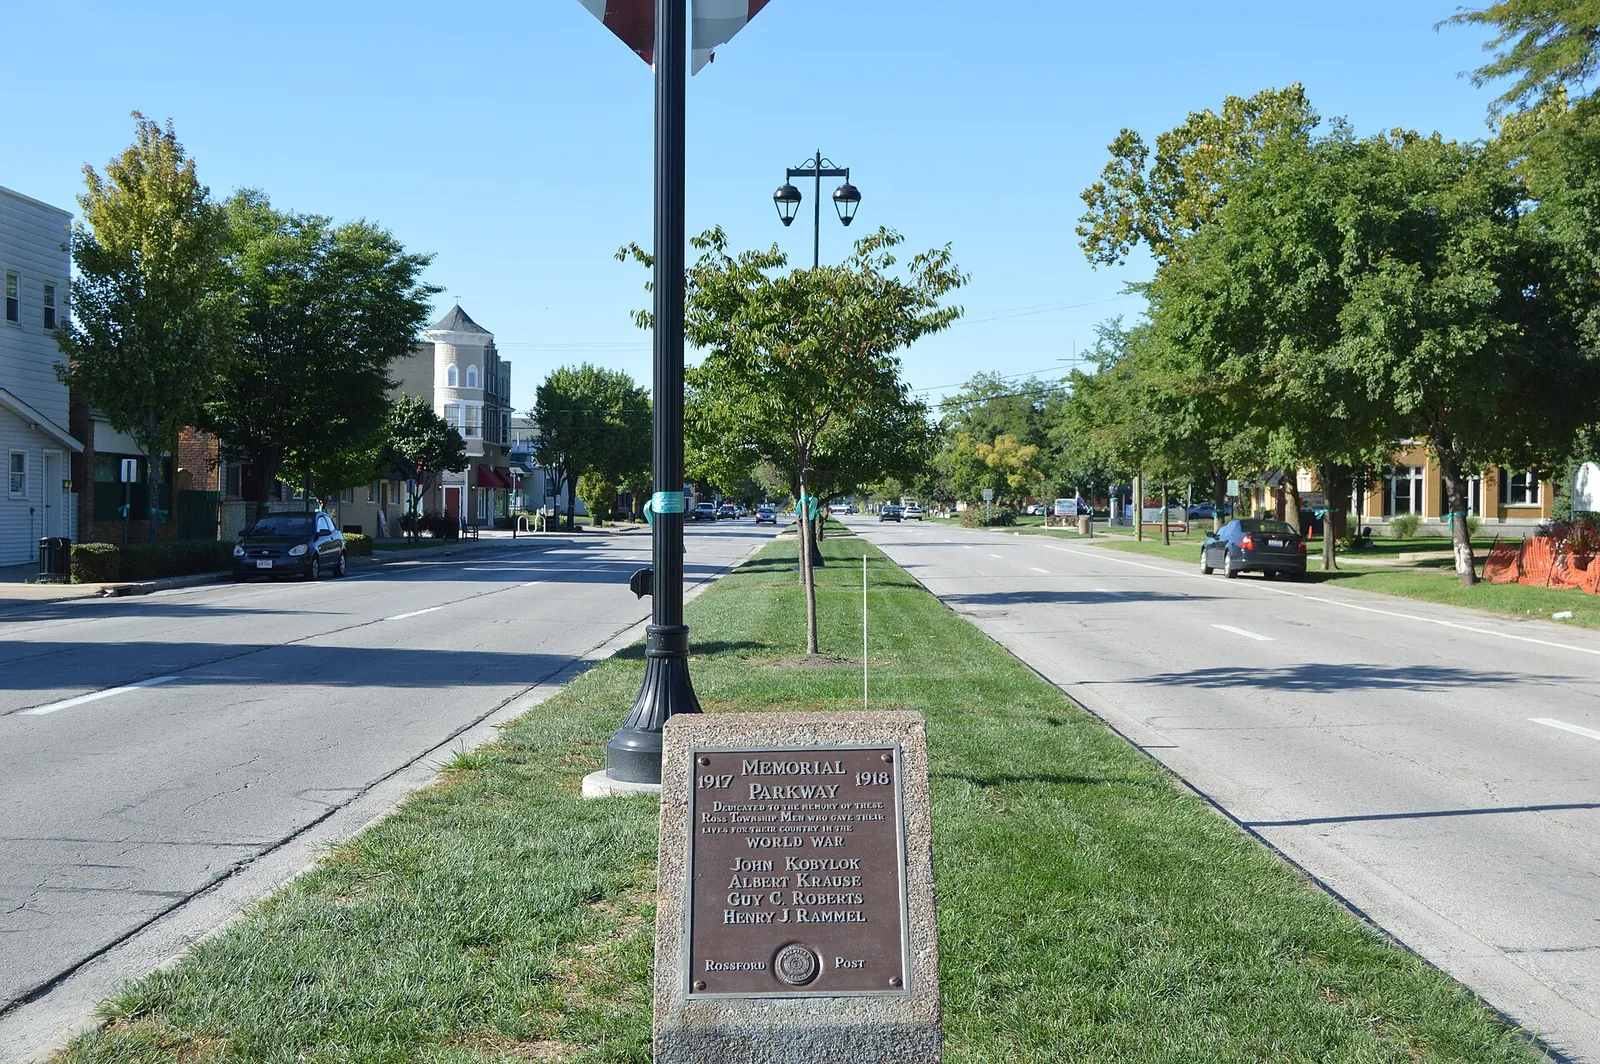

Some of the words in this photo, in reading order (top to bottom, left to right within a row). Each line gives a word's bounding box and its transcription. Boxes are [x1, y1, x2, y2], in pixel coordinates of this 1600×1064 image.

[741, 759, 846, 776] MEMORIAL
[698, 774, 734, 788] 1917
[855, 771, 890, 786] 1918
[749, 783, 839, 800] PARKWAY
[713, 801, 766, 812] DEDICATED
[701, 812, 727, 823] ROSS
[729, 812, 777, 823] TOWNSHIP
[780, 811, 804, 822] MEN
[746, 836, 803, 848] WORLD
[810, 836, 845, 848] WAR
[730, 857, 774, 872] JOHN
[785, 856, 861, 871] KOBYLOK
[728, 874, 791, 889] ALBERT
[796, 873, 862, 888] KRAUSE
[727, 892, 764, 906] GUY
[769, 891, 785, 906] C.
[792, 891, 864, 906] ROBERTS
[723, 909, 776, 925] HENRY
[777, 908, 792, 923] J.
[796, 908, 867, 923] RAMMEL
[705, 959, 767, 971] ROSSFORD
[834, 957, 866, 969] POST
